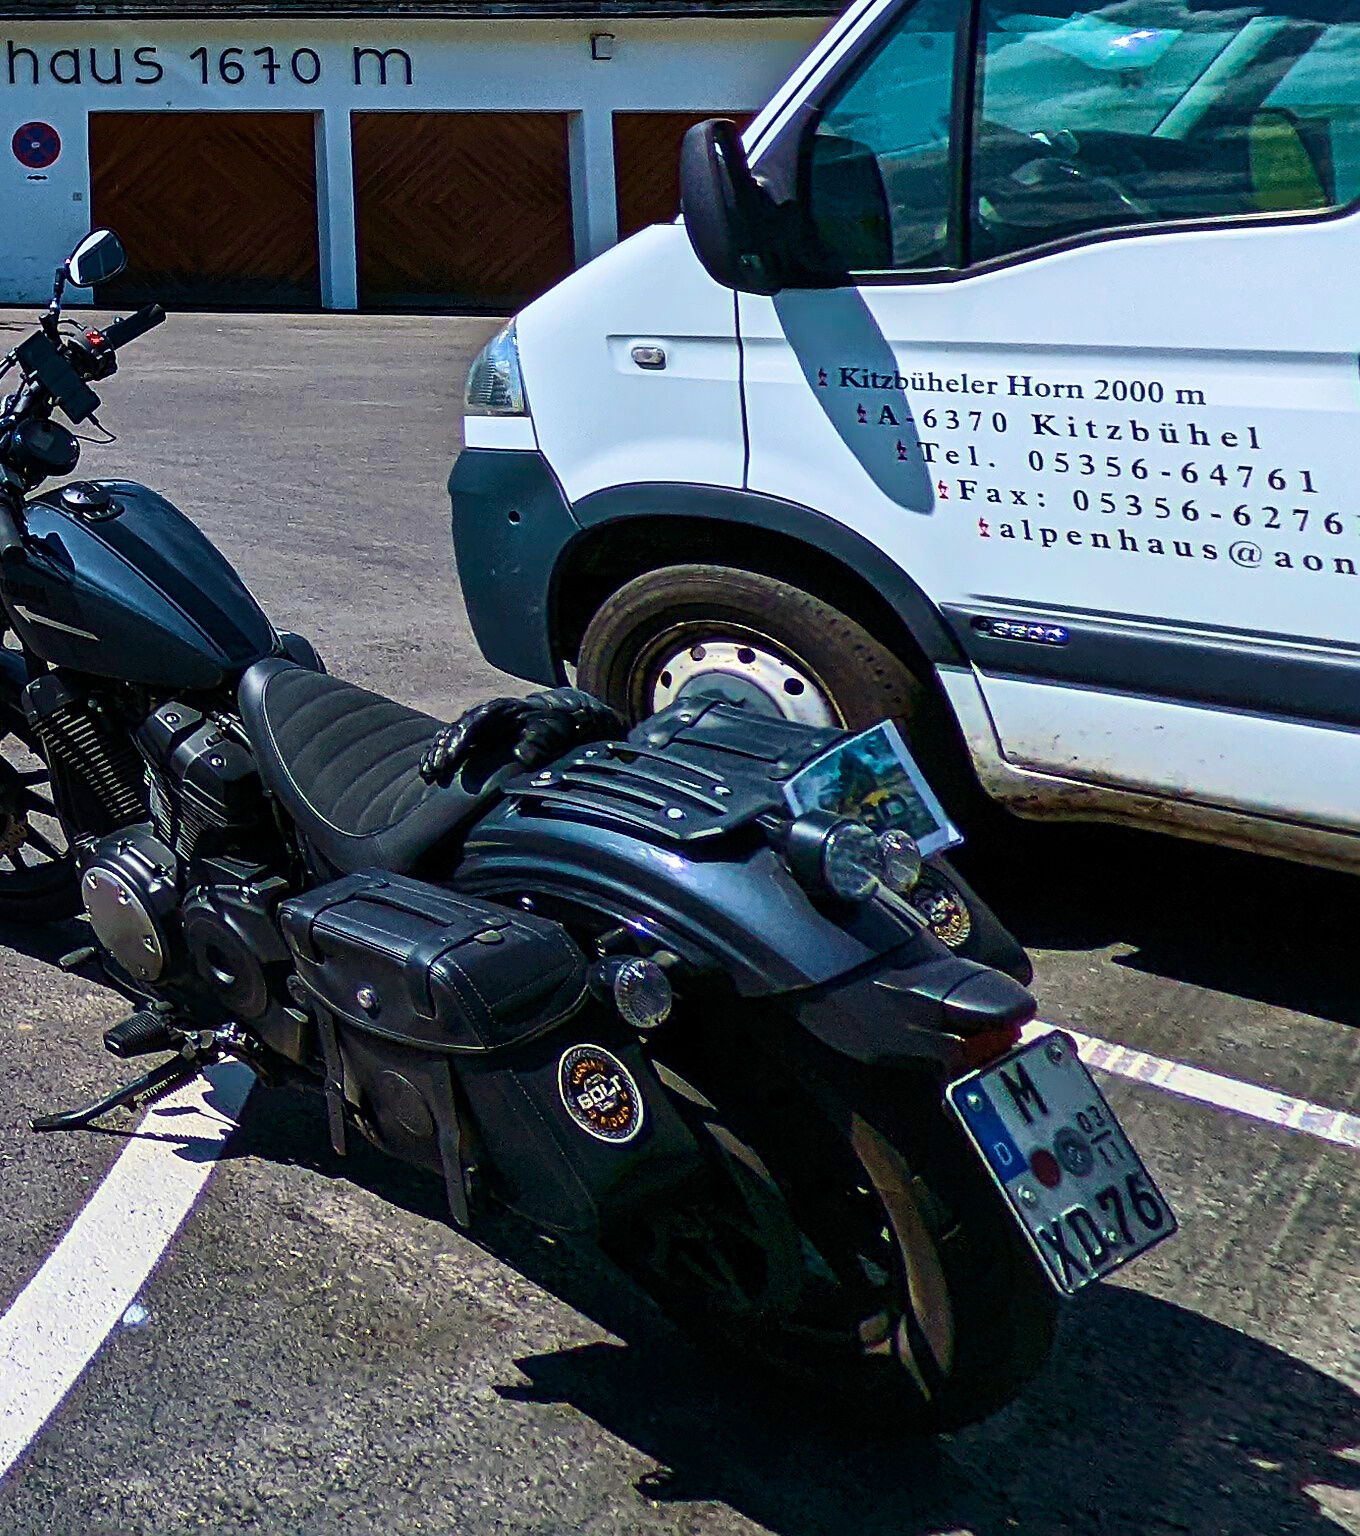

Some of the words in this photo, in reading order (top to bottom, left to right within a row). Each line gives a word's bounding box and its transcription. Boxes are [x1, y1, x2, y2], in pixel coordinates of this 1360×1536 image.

[189, 46, 321, 85] 1670
[353, 45, 414, 86] m
[839, 367, 998, 395] Kitzbüheler
[1006, 375, 1084, 399] Horn
[1094, 379, 1164, 403] 2000
[1176, 388, 1207, 406] m
[878, 405, 1007, 433] A-6370
[1031, 413, 1262, 450] Kitzbühel
[917, 441, 996, 468] Tel.
[1028, 449, 1319, 494] 05356-64761
[957, 479, 1046, 508] Fax:
[1073, 489, 1360, 536] 05356-6276
[577, 1074, 622, 1110] BOLT
[998, 1062, 1049, 1126] M
[992, 1142, 1013, 1166] D
[1094, 1171, 1164, 1245] 76
